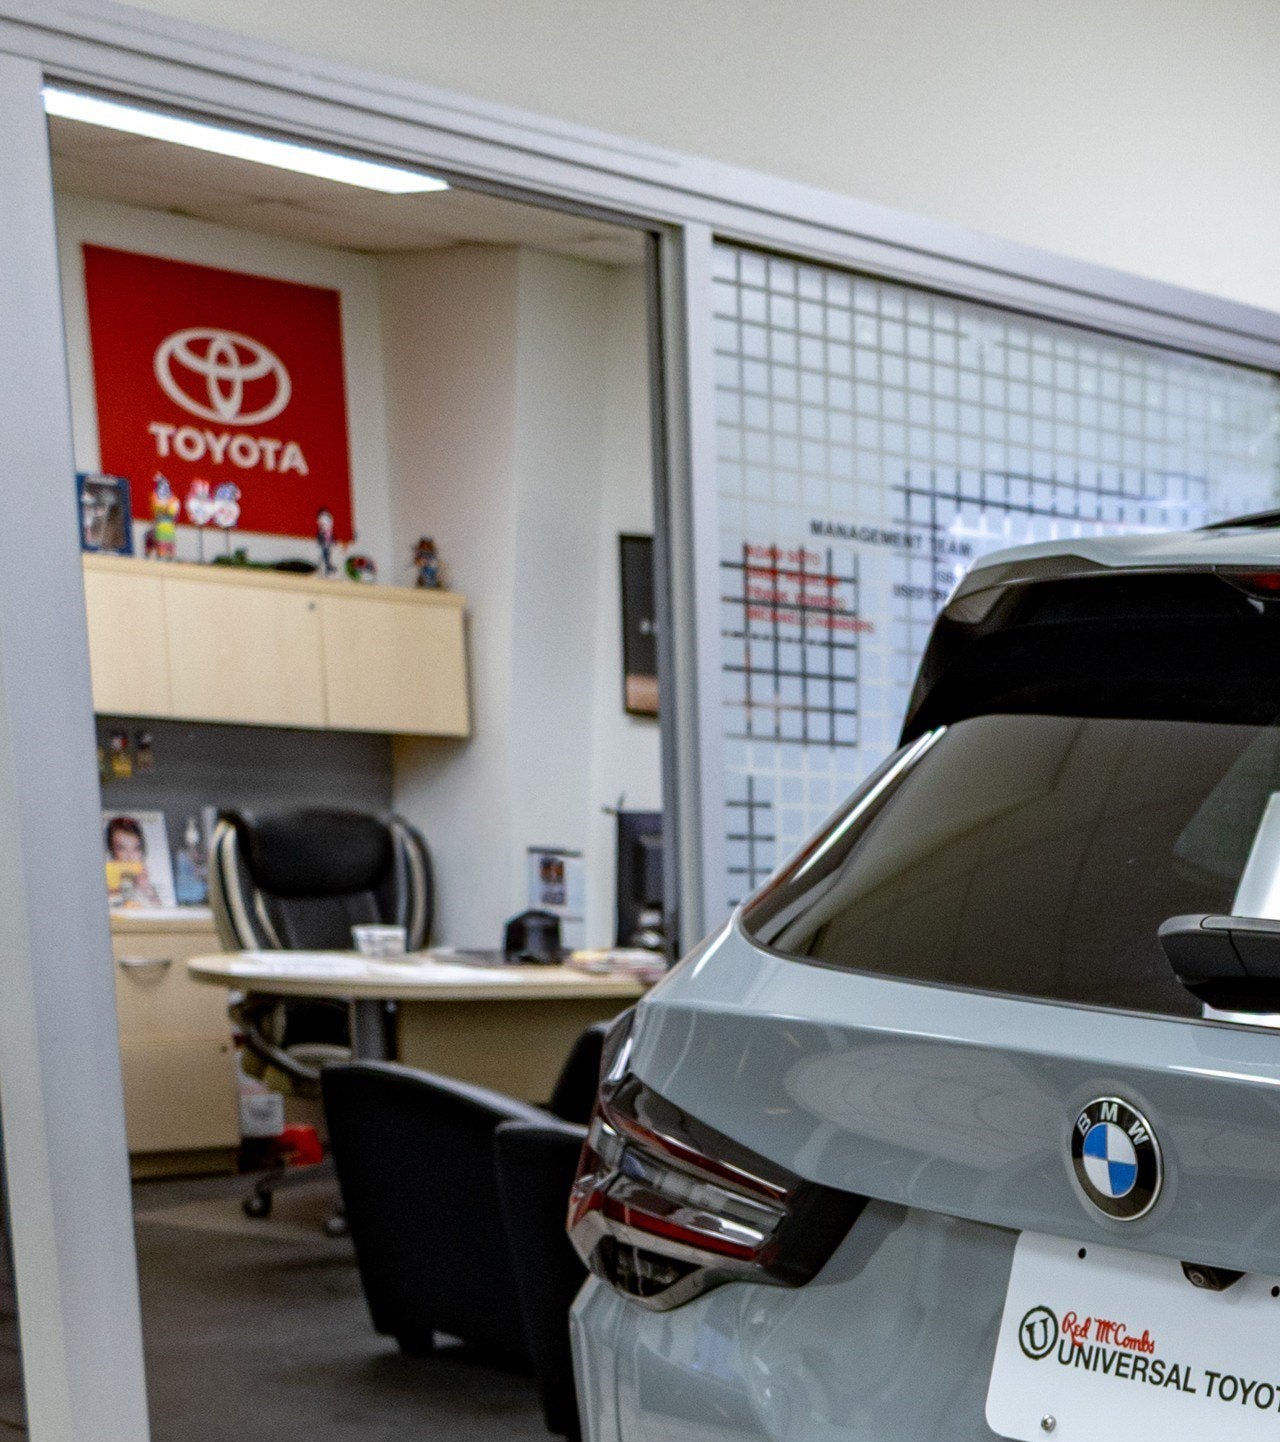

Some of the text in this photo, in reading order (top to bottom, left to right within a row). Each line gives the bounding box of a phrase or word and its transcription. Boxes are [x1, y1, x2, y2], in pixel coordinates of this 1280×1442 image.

[147, 421, 310, 477] TOYOTA
[810, 519, 922, 550] MANAGEMENT
[1077, 1101, 1150, 1146] BMW
[1062, 1311, 1155, 1354] Red McCombs
[1057, 1339, 1197, 1394] UNIVERSAL
